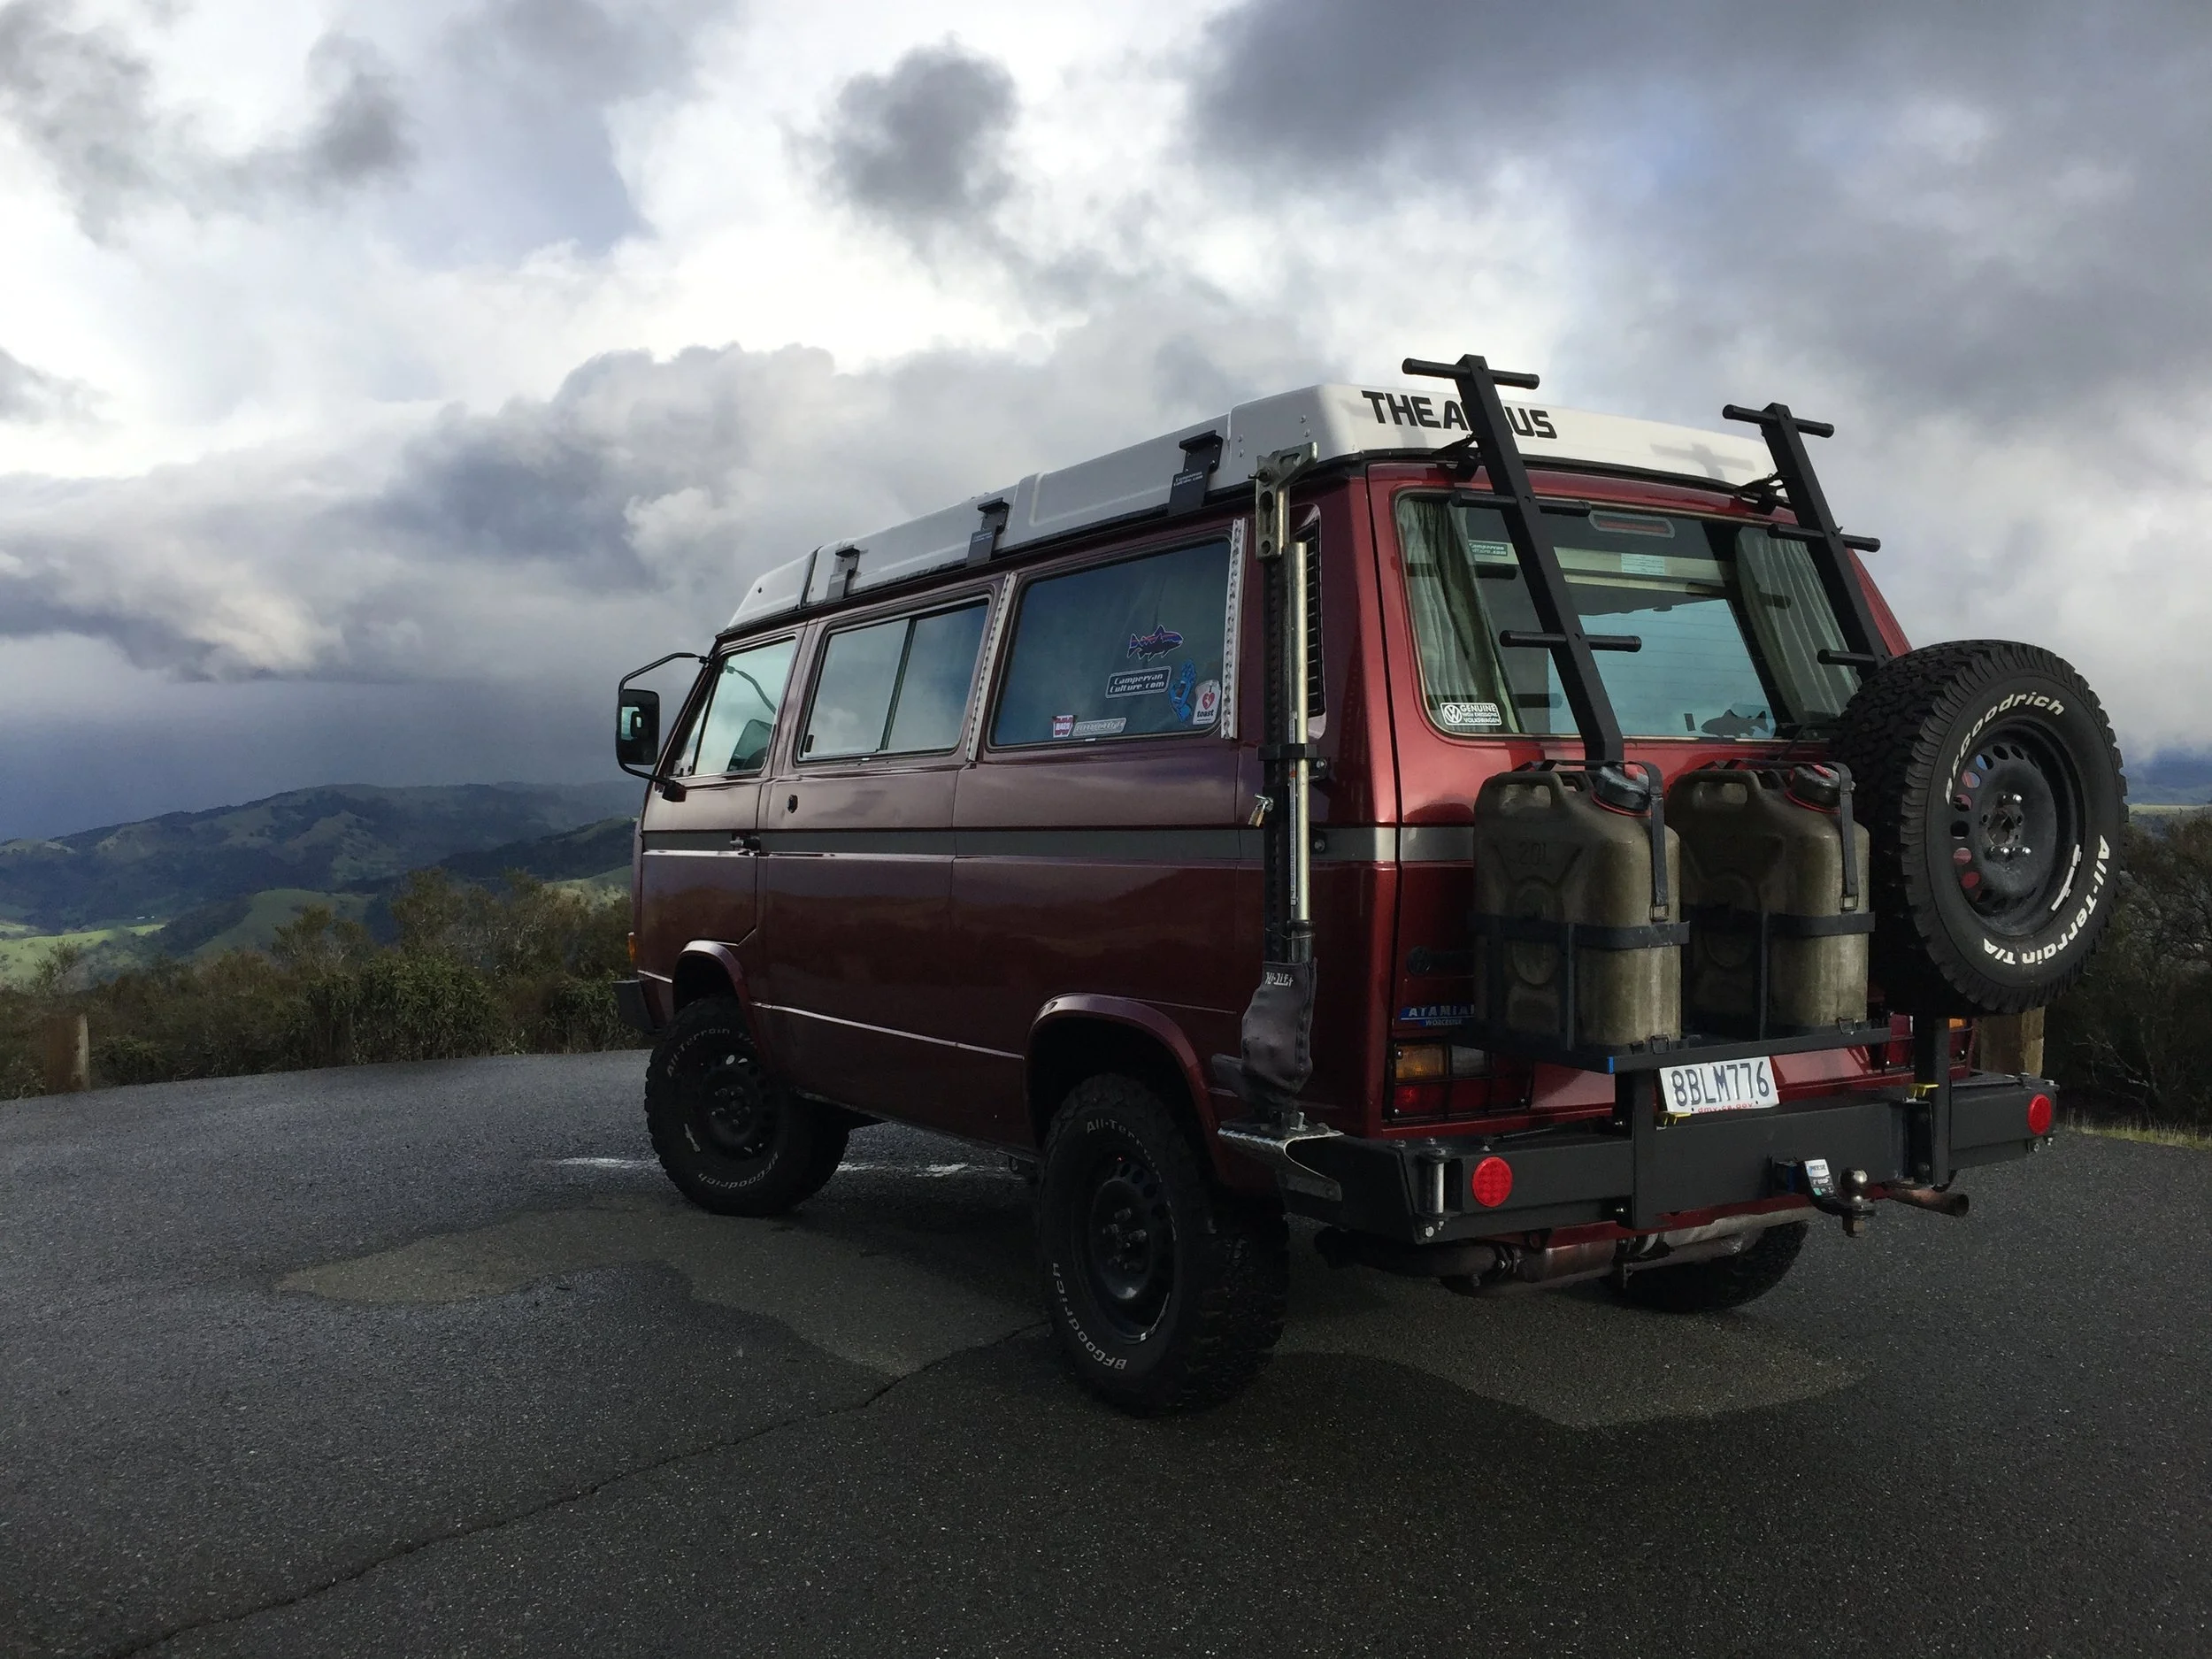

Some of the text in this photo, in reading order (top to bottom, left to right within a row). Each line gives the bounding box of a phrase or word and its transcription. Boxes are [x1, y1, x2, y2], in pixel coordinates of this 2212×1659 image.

[1110, 680, 1164, 693] Culture.com
[1114, 673, 1164, 685] Campervan
[1946, 691, 2065, 805] BFGoodrich
[2022, 835, 2111, 965] All-Terrain
[1671, 1061, 1770, 1107] 8BLM776
